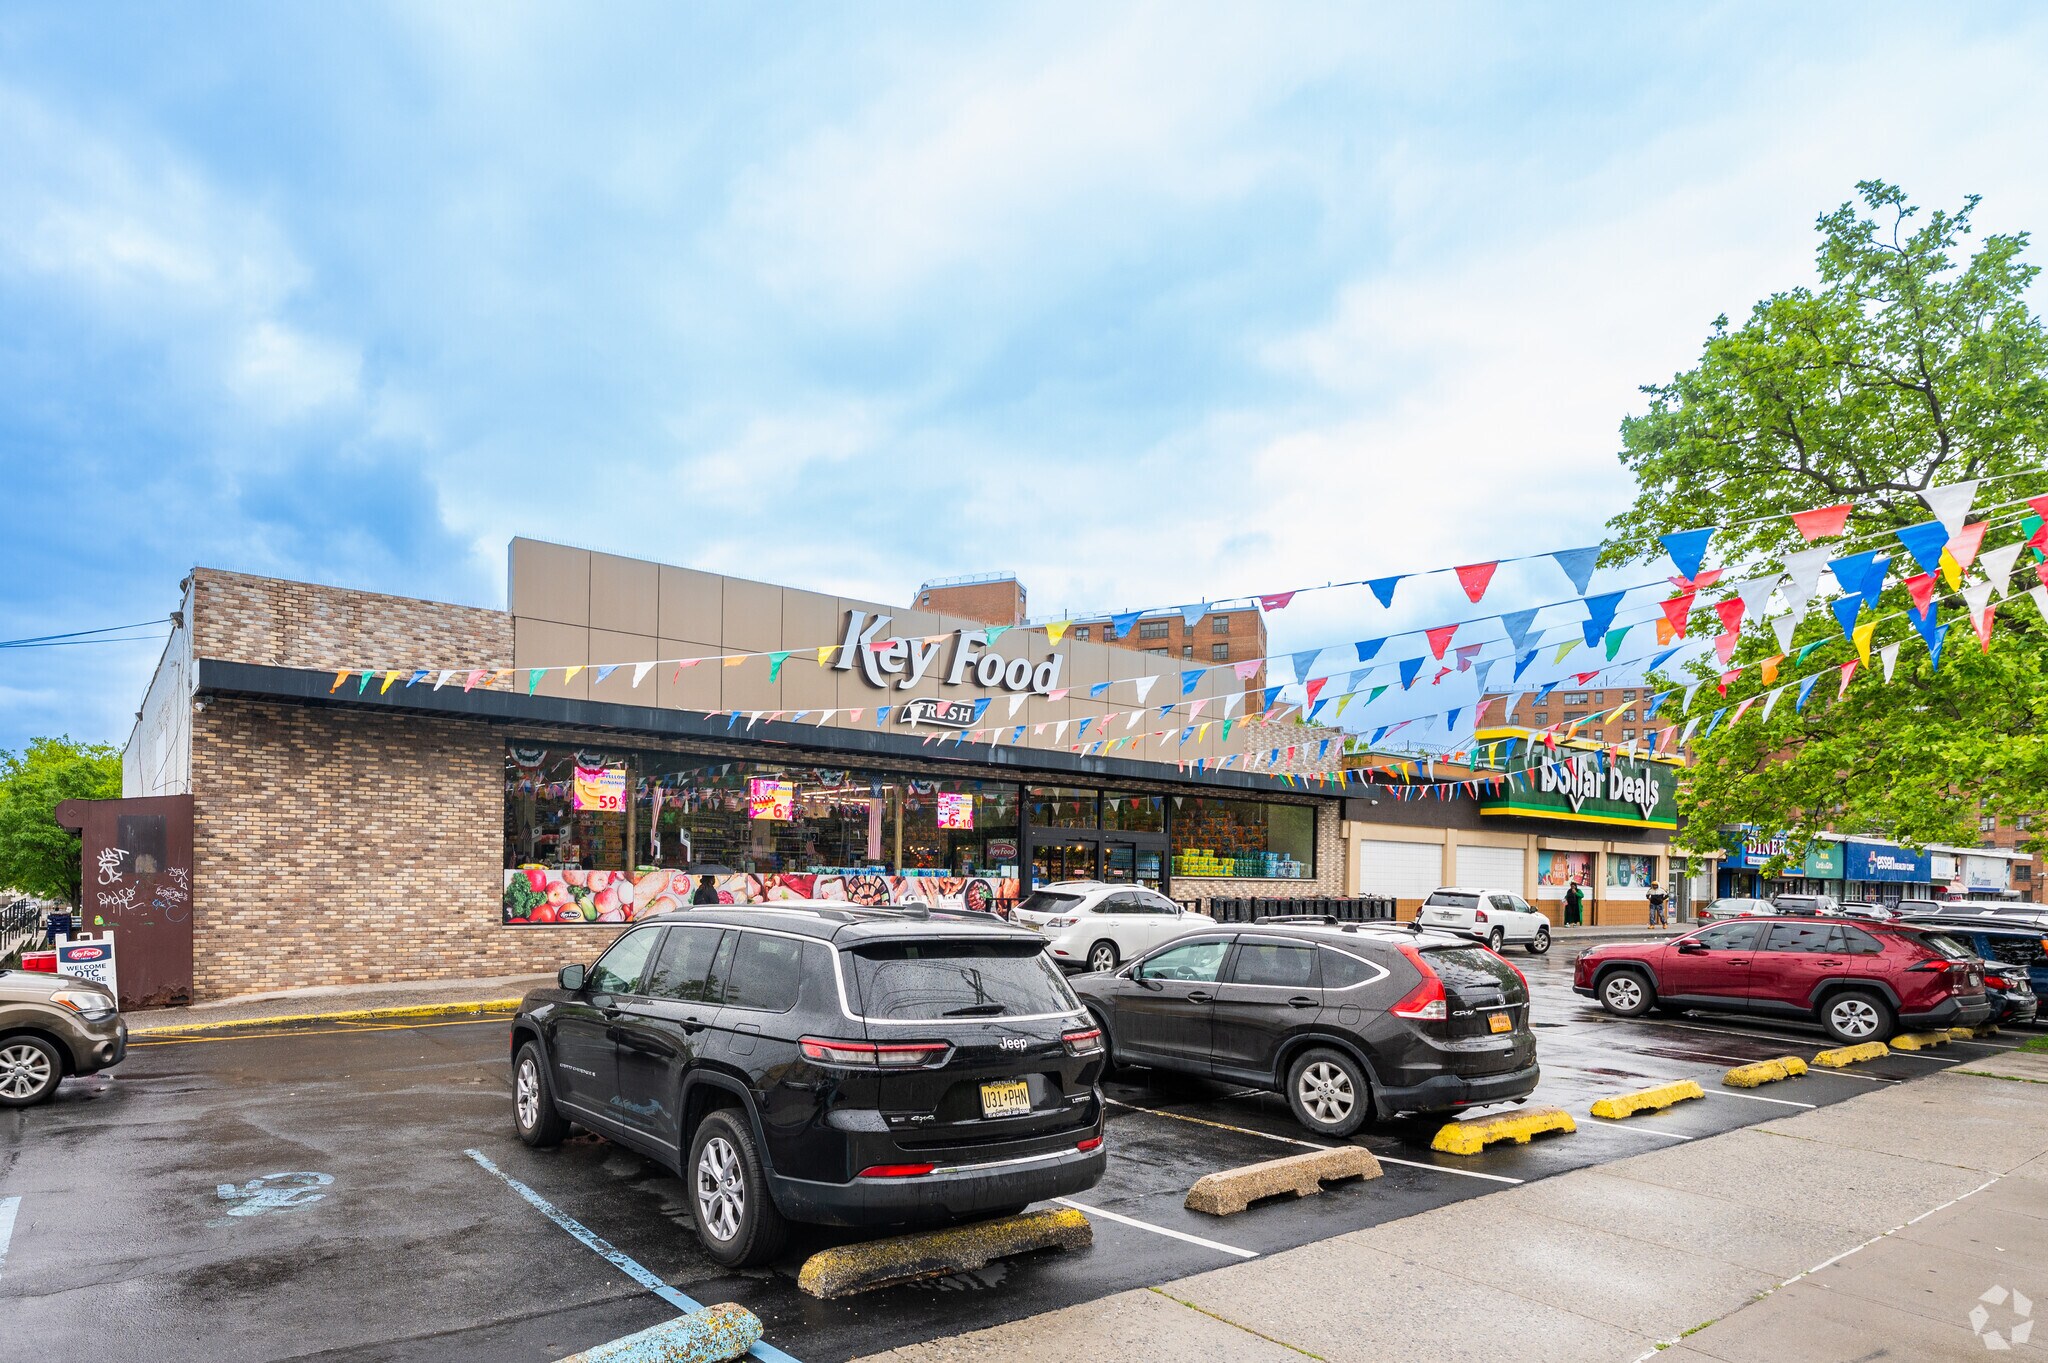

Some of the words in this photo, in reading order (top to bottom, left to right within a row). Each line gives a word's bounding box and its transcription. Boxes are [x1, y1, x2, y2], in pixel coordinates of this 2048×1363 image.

[834, 609, 941, 690] Key
[946, 629, 1063, 694] Food
[1541, 756, 1605, 814] Dollar
[1608, 767, 1659, 820] Deals
[598, 795, 618, 809] 59
[773, 803, 783, 819] 6
[948, 813, 956, 827] 6
[989, 847, 1000, 856] Key
[1000, 847, 1014, 856] Food
[1877, 856, 1895, 870] essen
[71, 950, 84, 958] Key
[83, 949, 100, 957] Food
[66, 963, 107, 972] WELCOME
[74, 969, 100, 978] OTC
[999, 1036, 1028, 1051] Jeep
[984, 1091, 1004, 1109] U31
[1008, 1088, 1028, 1106] PHN
